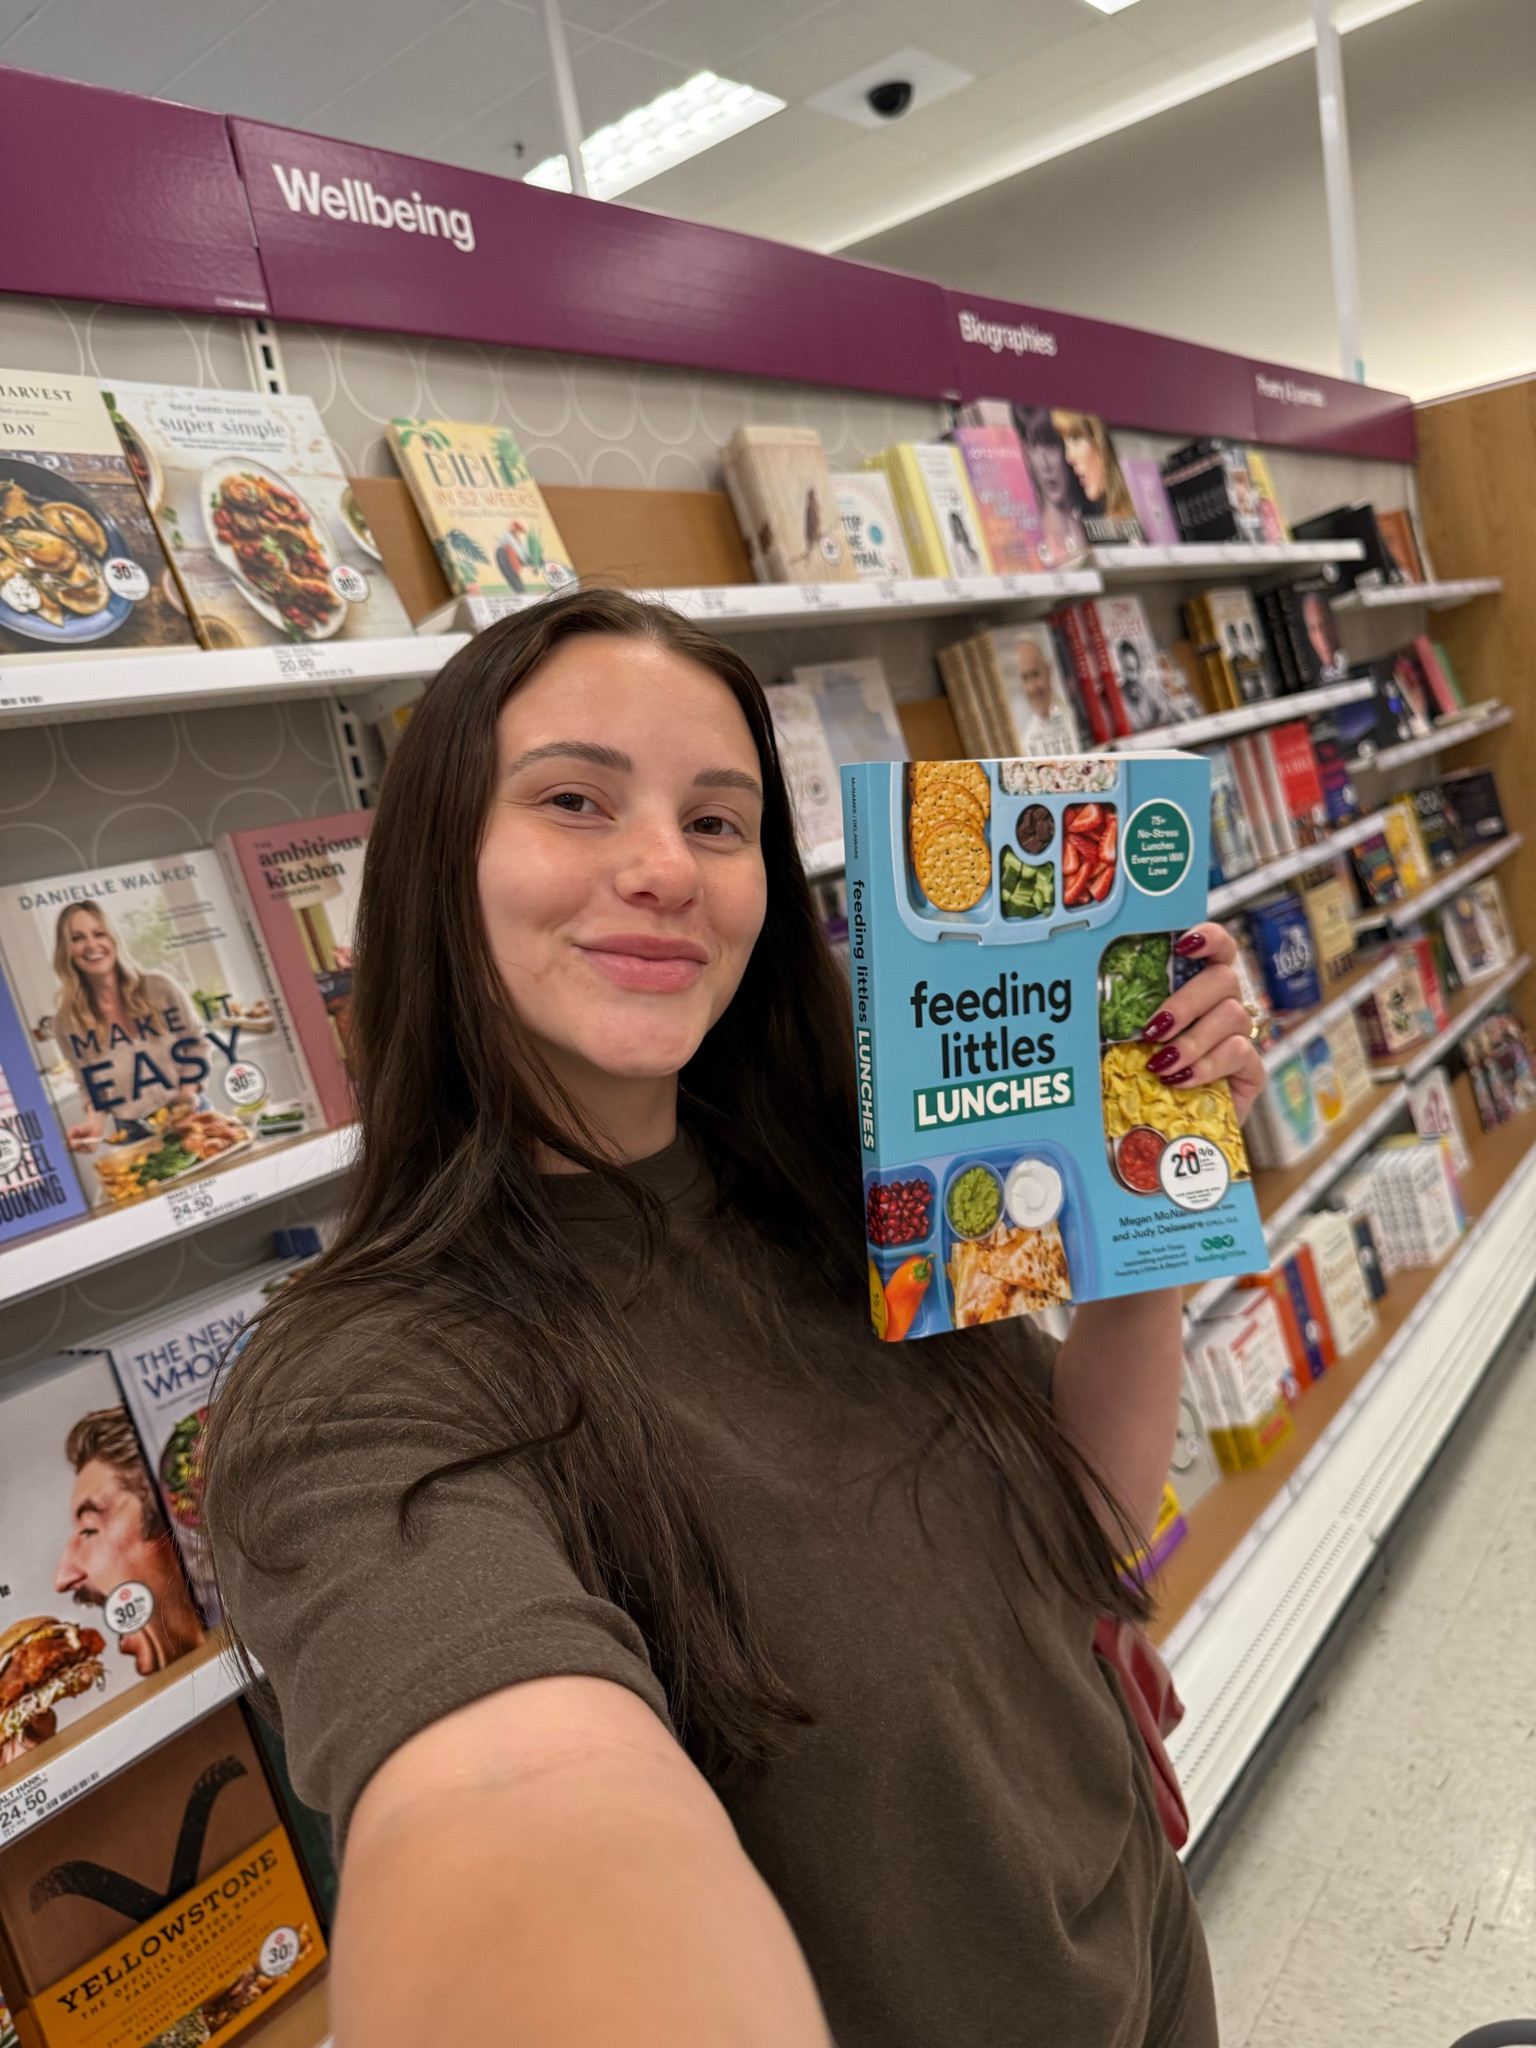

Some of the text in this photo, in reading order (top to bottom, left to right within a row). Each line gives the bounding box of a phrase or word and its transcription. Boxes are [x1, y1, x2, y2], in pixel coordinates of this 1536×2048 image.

[272, 164, 476, 253] Wellbeing
[959, 310, 1057, 357] Biographies
[3, 423, 35, 436] DAY
[159, 417, 285, 441] super simple
[1137, 829, 1179, 838] No-Stress
[1151, 816, 1166, 825] 75+
[259, 837, 364, 867] ambitious
[1131, 852, 1184, 865] Everyone Will
[1141, 841, 1175, 851] Lunches
[18, 879, 118, 910] DANIELLE
[119, 864, 198, 890] WALKER
[264, 862, 346, 889] kitchen
[1148, 867, 1168, 876] Love
[853, 880, 875, 1150] feeding littles LUNCHES
[910, 971, 1072, 1028] feeding
[70, 993, 232, 1059] MAKE IT
[81, 1025, 241, 1112] EASY
[941, 1026, 1056, 1079] littles
[918, 1072, 1071, 1126] LUNCHES
[172, 1194, 213, 1219] 24.50
[1119, 1213, 1152, 1227] Megan
[1112, 1231, 1130, 1242] and
[1132, 1227, 1155, 1239] Judy
[1157, 1220, 1203, 1234] Delaware
[134, 1309, 244, 1374] THE NEW
[16, 1774, 41, 1793] HANK
[0, 1788, 47, 1829] 24.50
[57, 1848, 278, 2013] YELLOWSTONE
[81, 1999, 107, 2020] THE
[113, 1951, 175, 1998] OFFICIAL
[181, 1912, 229, 1950] DUTTON
[125, 1913, 242, 2002] FAMILY COOKBOOK
